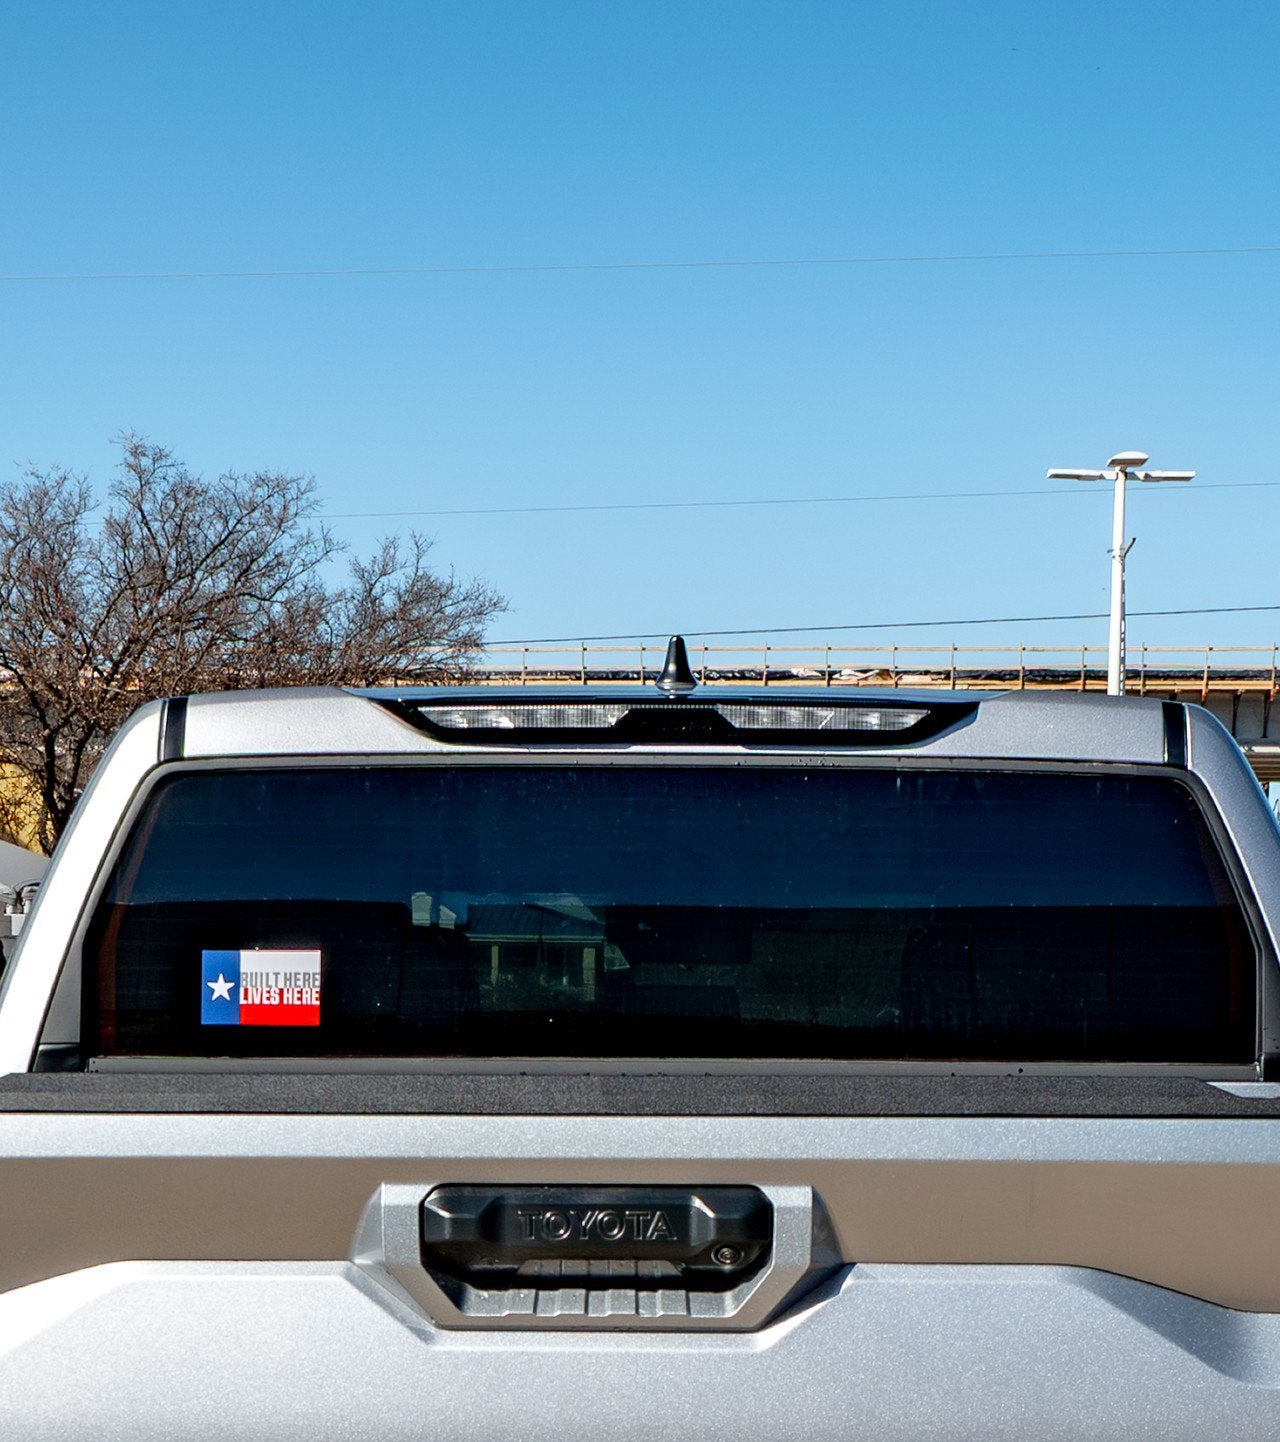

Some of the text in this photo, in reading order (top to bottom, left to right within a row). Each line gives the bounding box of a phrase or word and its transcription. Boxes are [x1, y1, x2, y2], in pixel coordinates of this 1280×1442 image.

[240, 971, 320, 988] BUILT HERE
[239, 987, 320, 1005] LIVES HERE
[517, 1209, 678, 1242] TOYOTA
